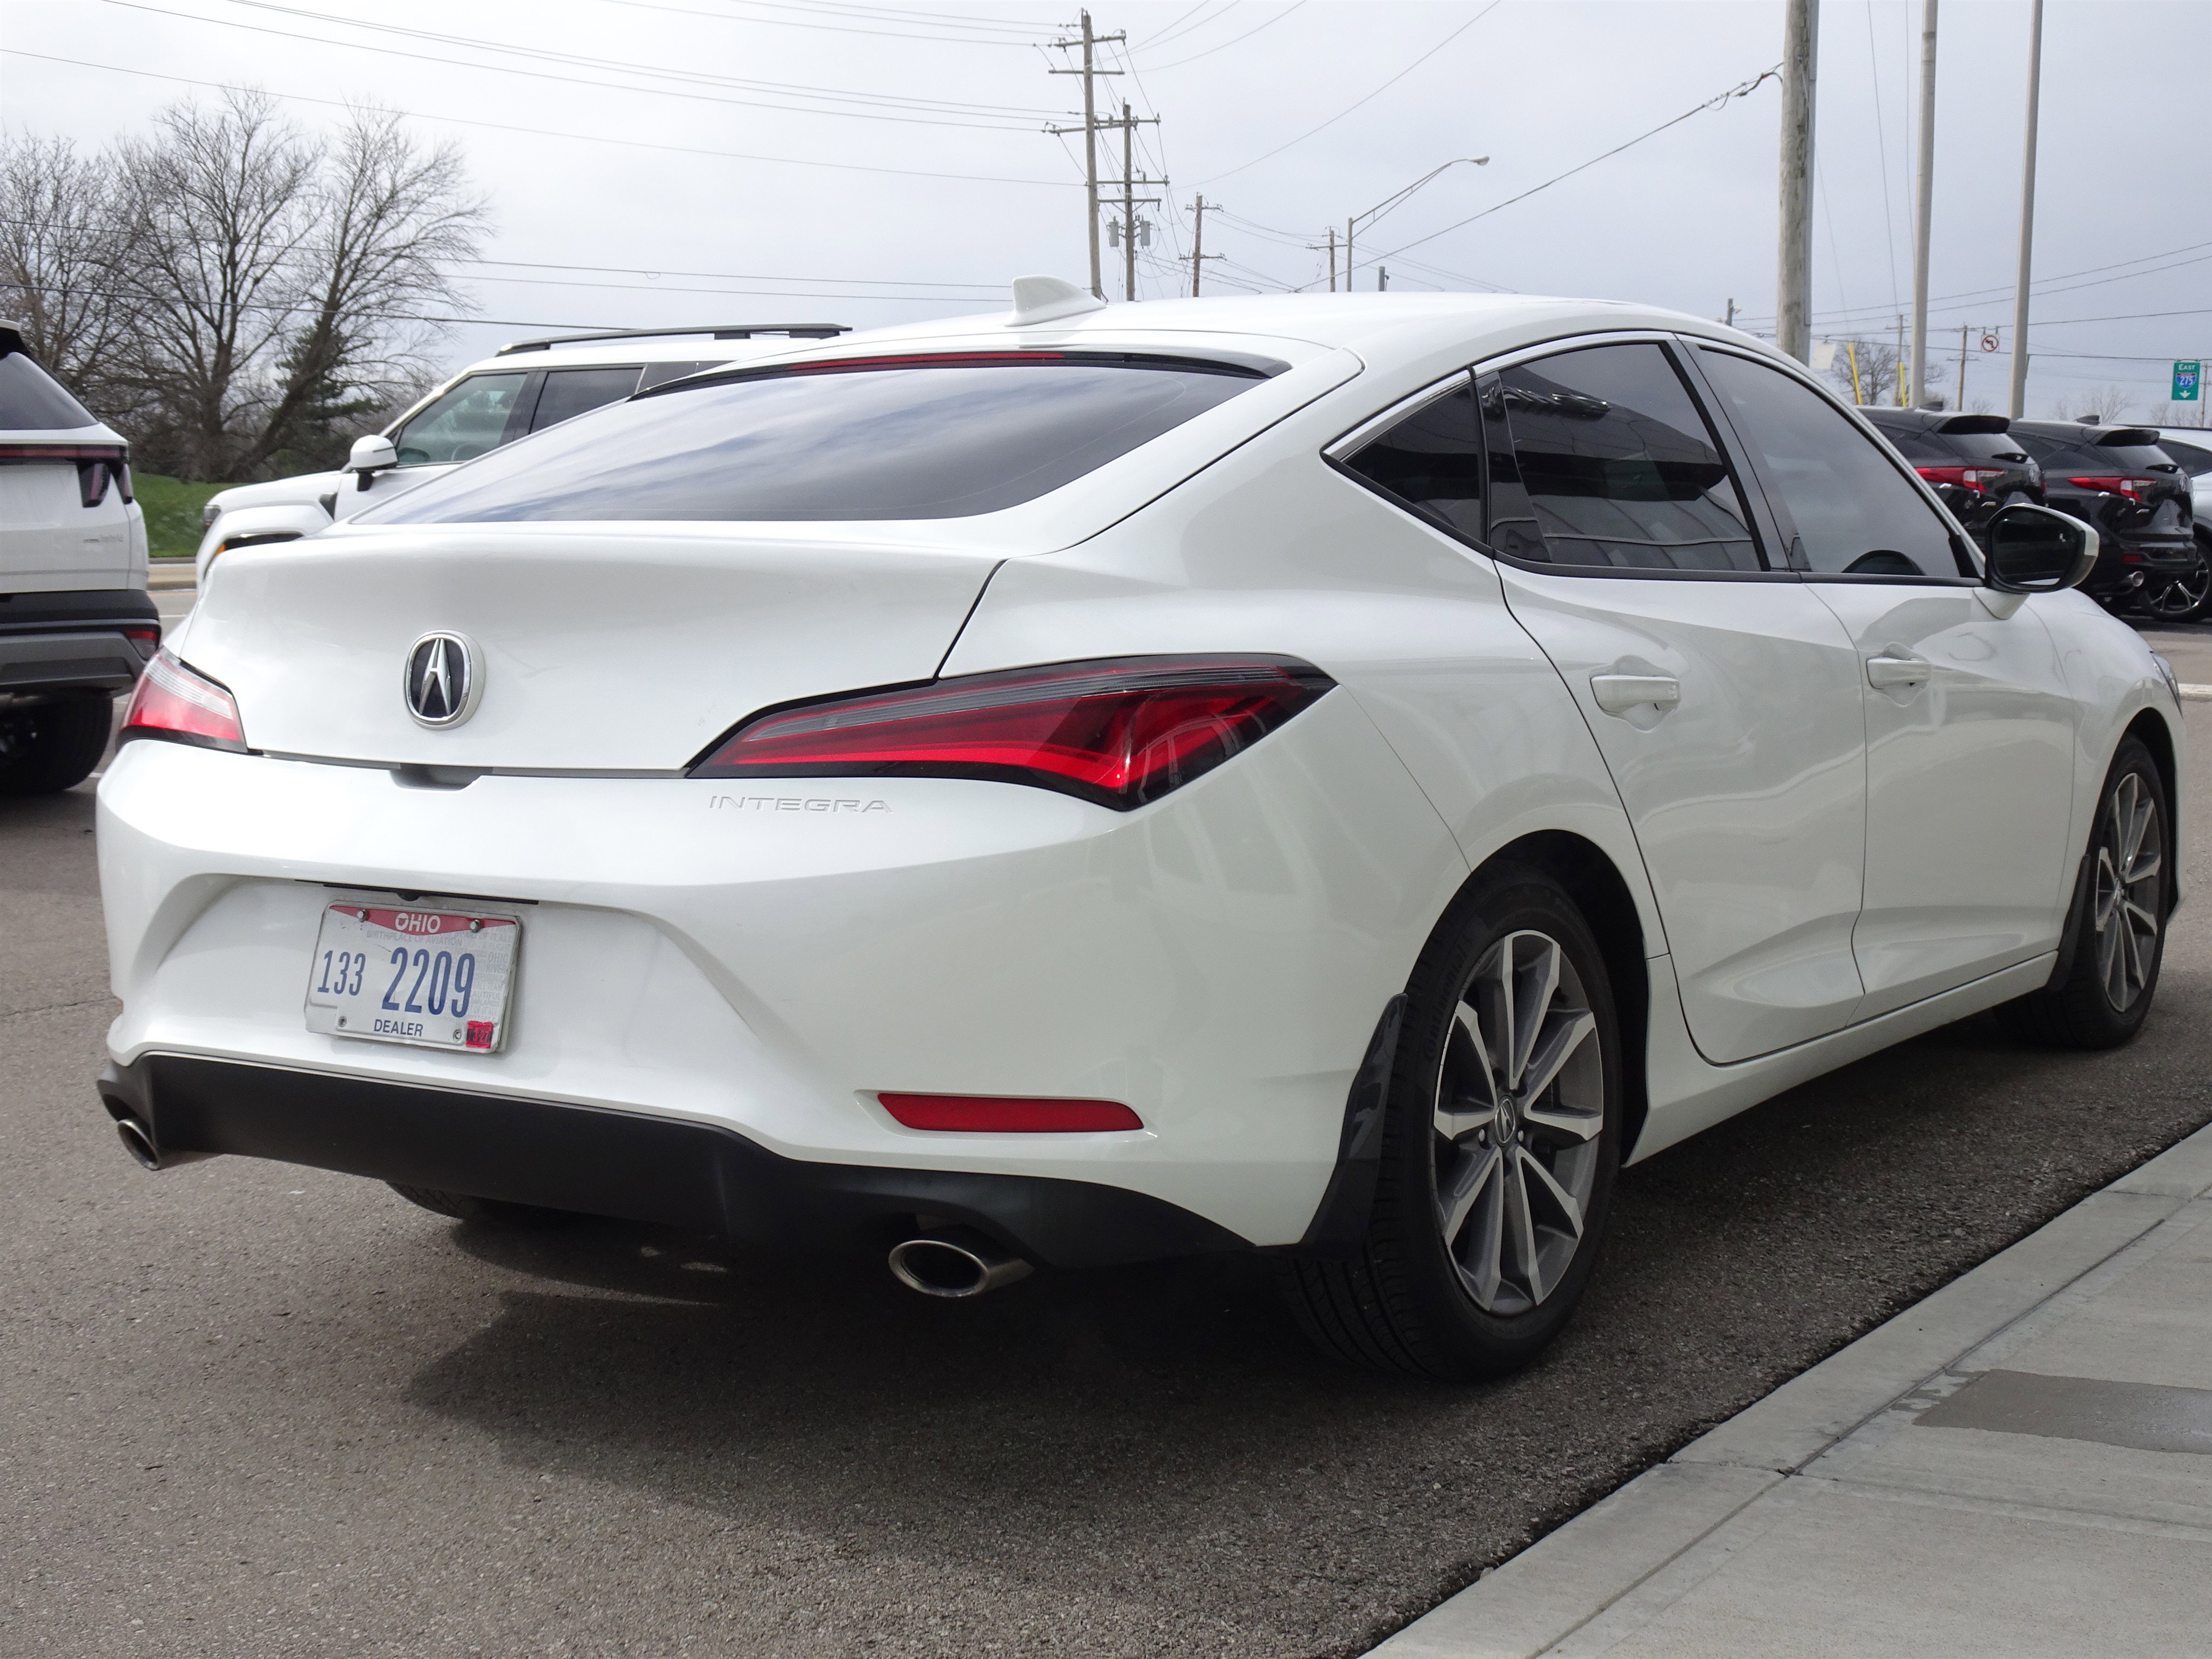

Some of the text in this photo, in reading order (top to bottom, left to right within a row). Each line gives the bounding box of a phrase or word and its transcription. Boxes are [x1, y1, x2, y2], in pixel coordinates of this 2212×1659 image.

[2180, 375, 2193, 386] 275
[709, 795, 894, 813] INTEGRA
[395, 912, 441, 934] OHIO
[366, 930, 412, 942] BIRTHPLACE
[426, 935, 462, 946] AVIATION
[317, 950, 366, 996] 133
[381, 947, 475, 1018] 2209
[373, 1019, 423, 1037] DEALER
